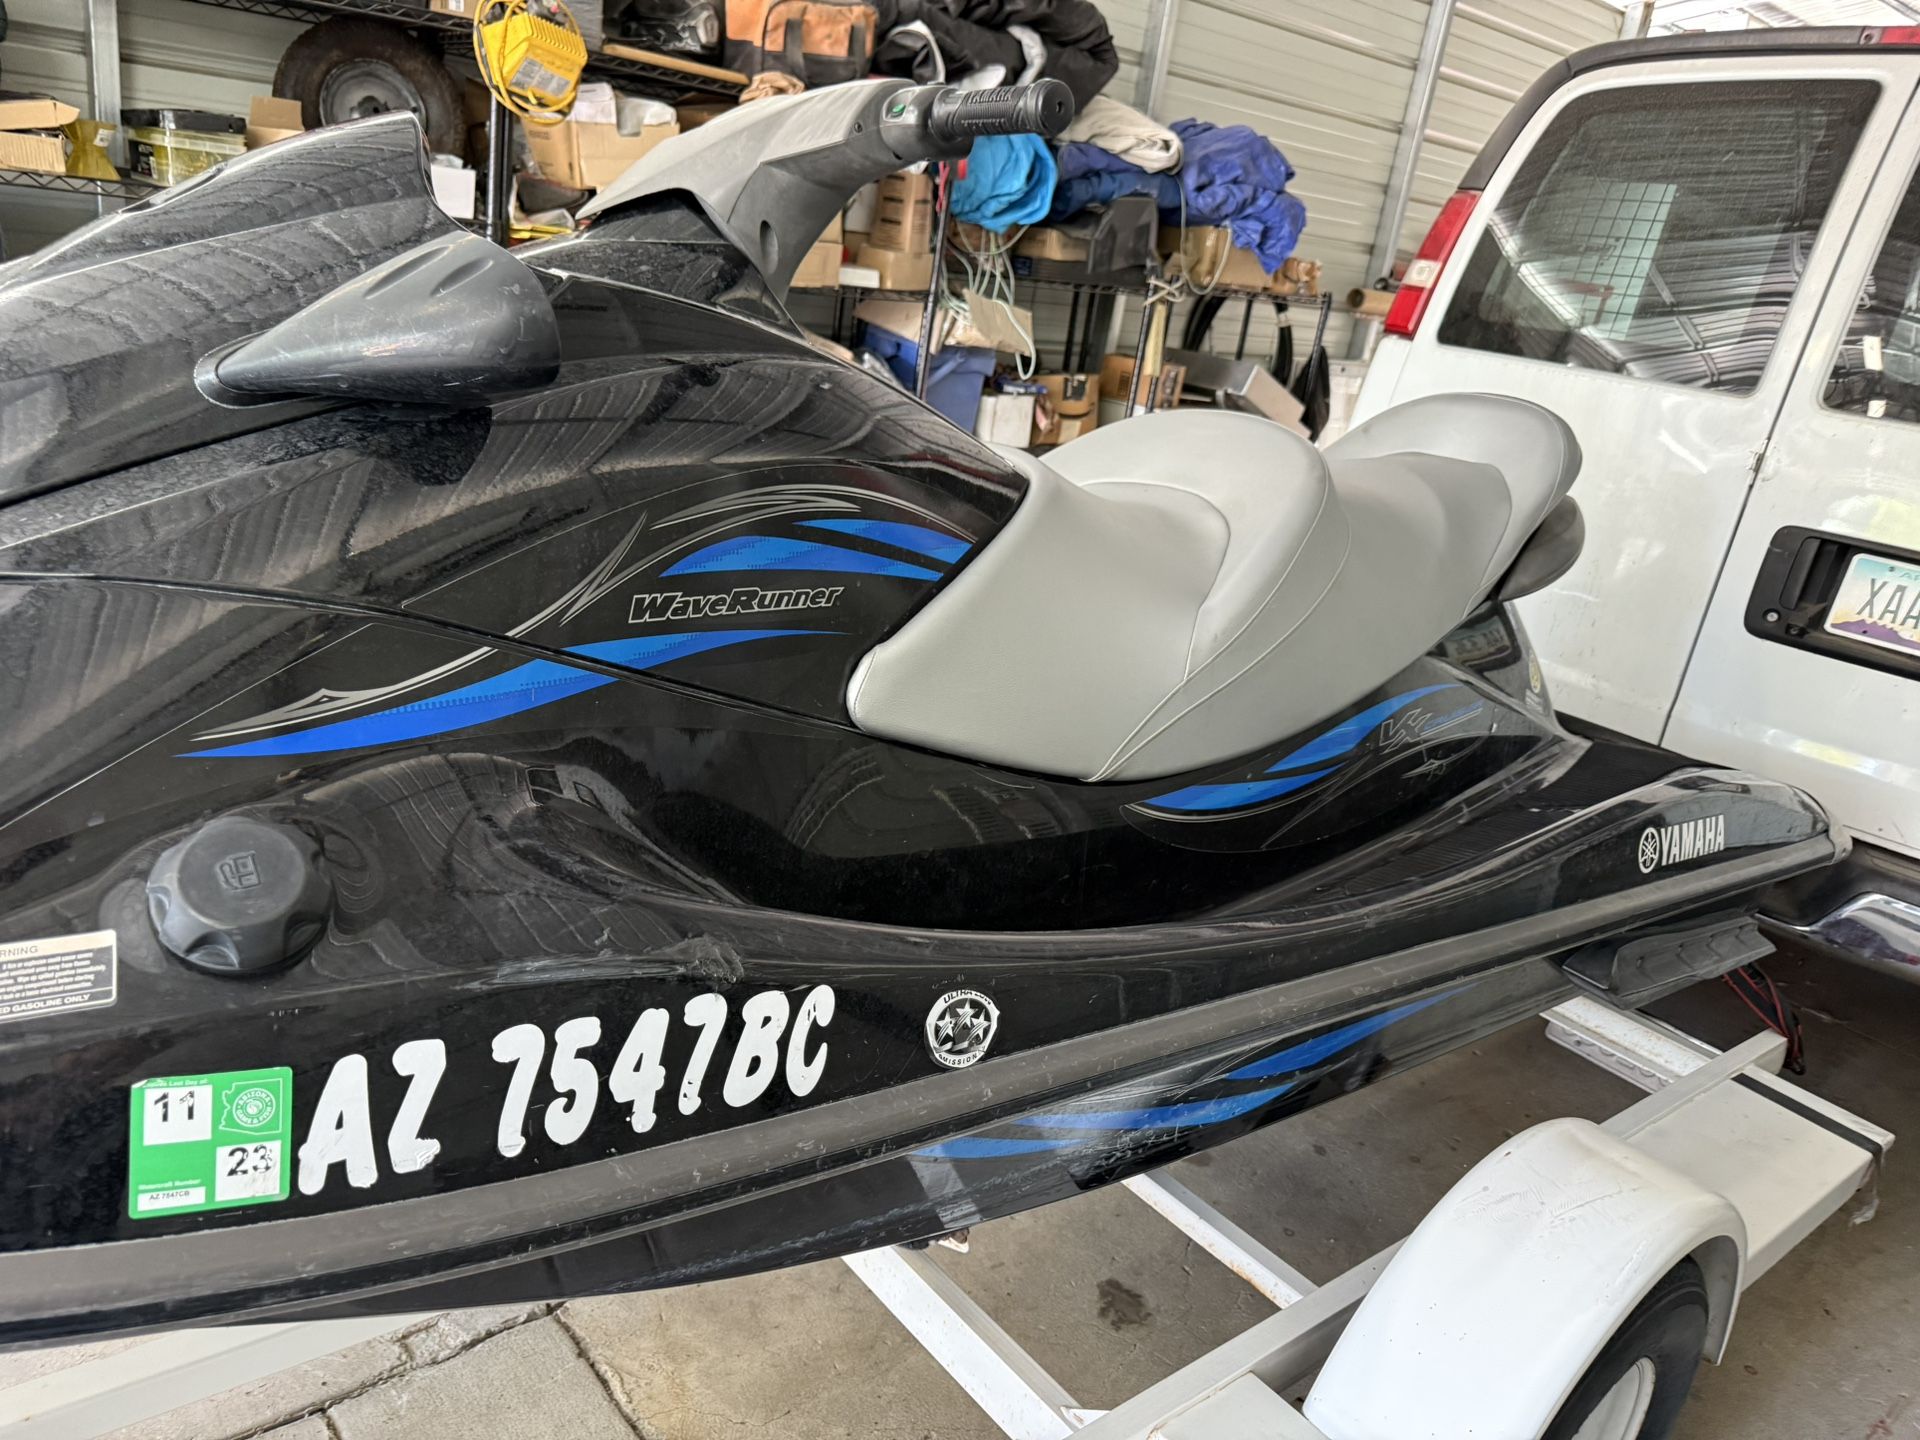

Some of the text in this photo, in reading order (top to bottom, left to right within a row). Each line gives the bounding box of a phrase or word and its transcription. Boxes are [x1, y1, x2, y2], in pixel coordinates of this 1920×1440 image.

[628, 586, 844, 624] WaveRunner
[1660, 814, 1724, 867] YAMAHA
[12, 998, 63, 1012] GASOLINE
[64, 993, 91, 1004] ONLY
[154, 1090, 195, 1123] 11
[238, 1090, 272, 1106] ARIZONA
[297, 1038, 447, 1195] AZ
[226, 1144, 273, 1177] 23
